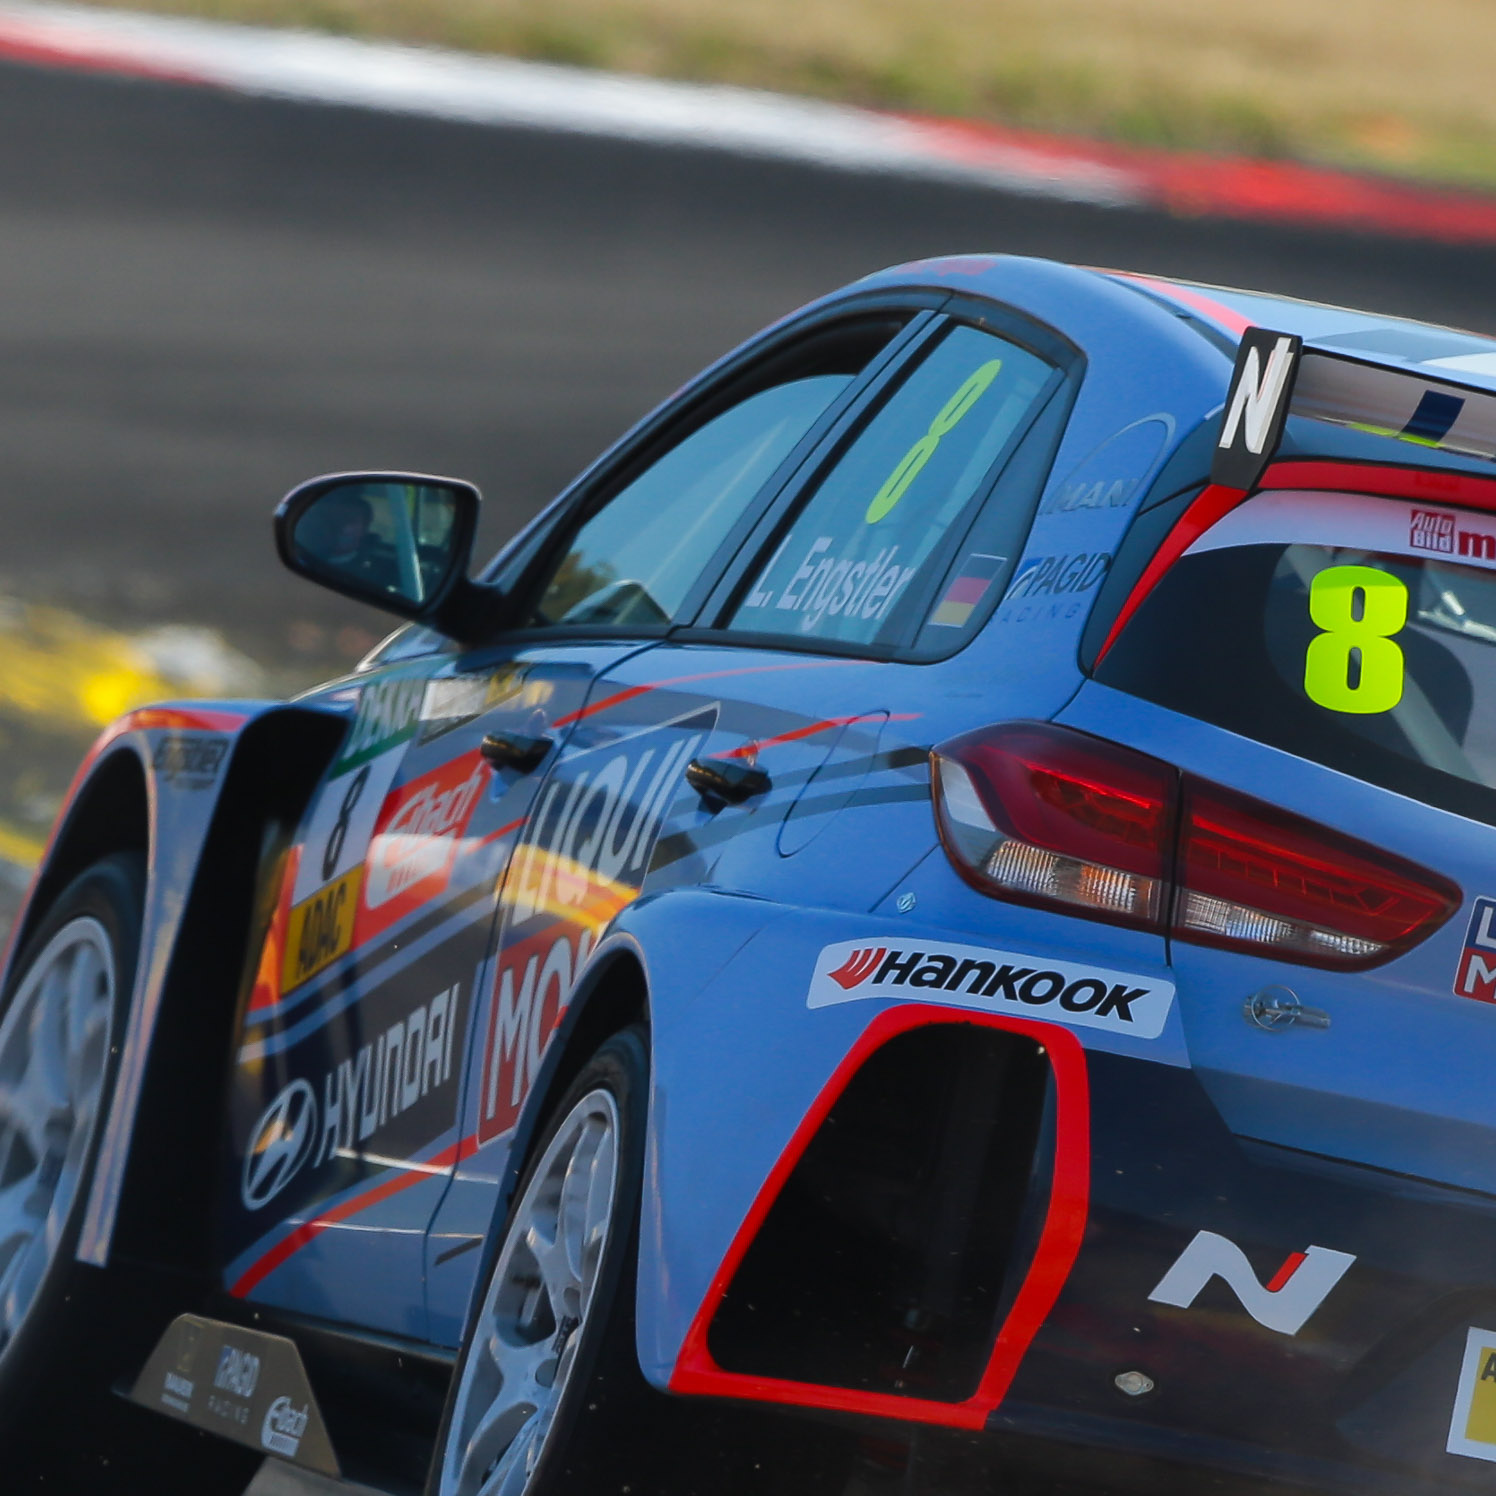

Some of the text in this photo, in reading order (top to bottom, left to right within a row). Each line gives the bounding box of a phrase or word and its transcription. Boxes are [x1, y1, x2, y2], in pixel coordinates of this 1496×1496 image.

[865, 358, 1003, 524] 8
[774, 536, 916, 630] Engstler
[1304, 564, 1408, 714] 8
[322, 765, 371, 882] 8
[511, 733, 703, 927] LIQUI
[313, 982, 461, 1169] HYUNDAI
[1147, 1230, 1357, 1335] N
